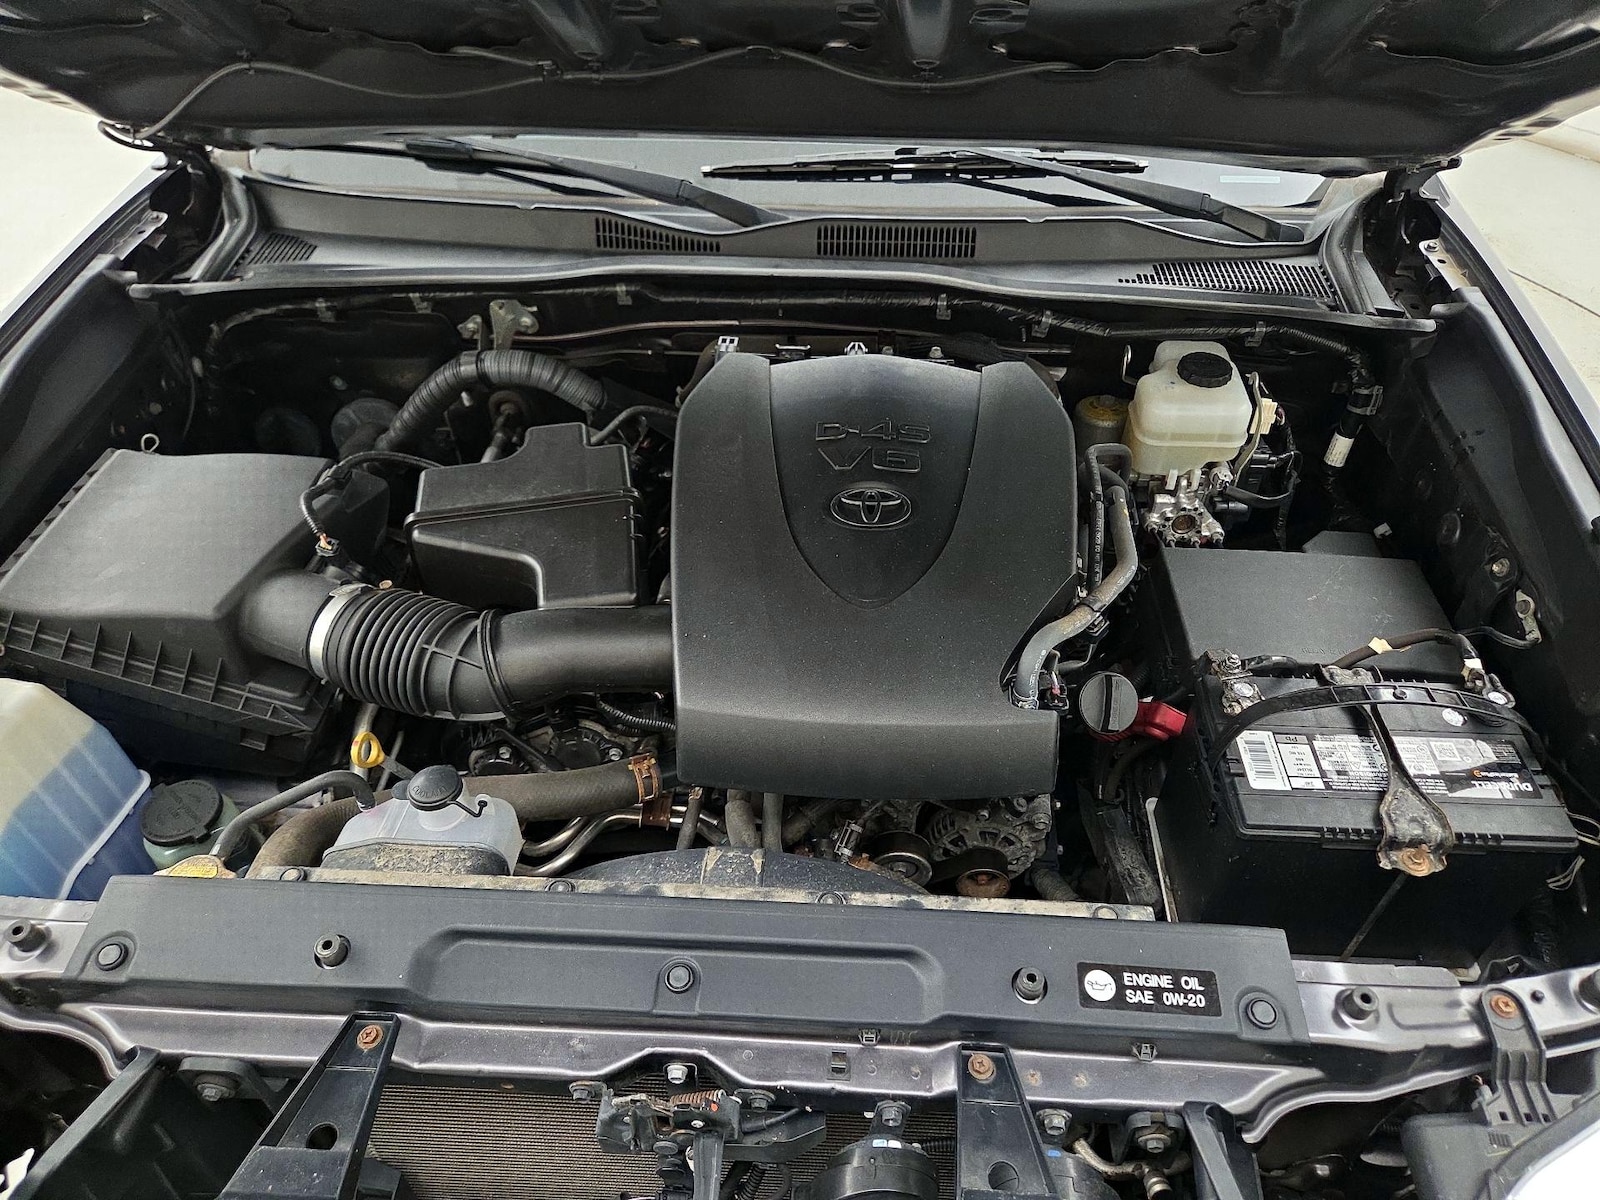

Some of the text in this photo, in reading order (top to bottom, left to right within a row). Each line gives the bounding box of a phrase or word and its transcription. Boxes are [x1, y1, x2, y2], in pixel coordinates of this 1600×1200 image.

[815, 419, 931, 443] D-4S
[817, 446, 921, 473] V6
[1471, 780, 1533, 792] DURACELL
[1122, 971, 1205, 991] ENGINE OIL
[1125, 989, 1206, 1008] SAE 0W-20
